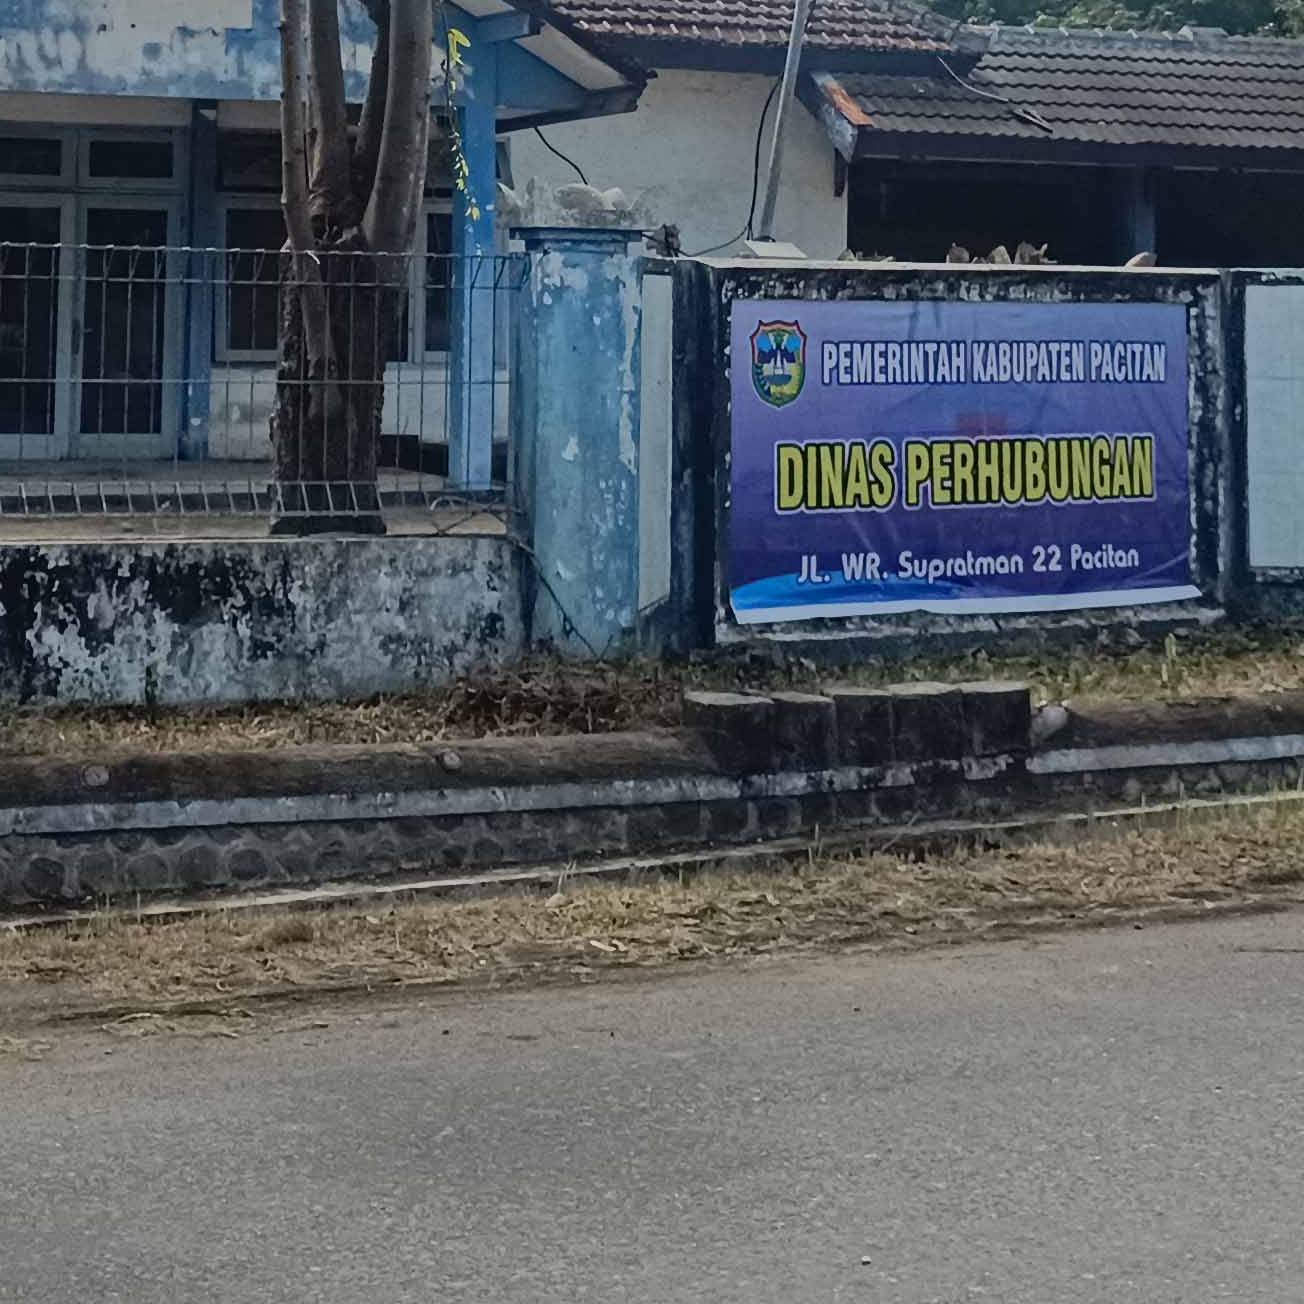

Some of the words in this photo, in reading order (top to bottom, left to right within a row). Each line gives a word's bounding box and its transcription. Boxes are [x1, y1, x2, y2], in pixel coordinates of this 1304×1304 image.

[822, 342, 966, 384] PEMERINTAH
[972, 341, 1085, 383] KABUPATEN
[1090, 342, 1166, 383] PACITAN
[777, 441, 894, 510] DINAS
[904, 434, 1154, 506] PERHUBUNGAN
[798, 554, 830, 583] JL.
[842, 551, 888, 581] WR.
[898, 550, 1024, 584] Supratman
[1032, 545, 1062, 572] 22
[1070, 543, 1139, 571] Pacitan
